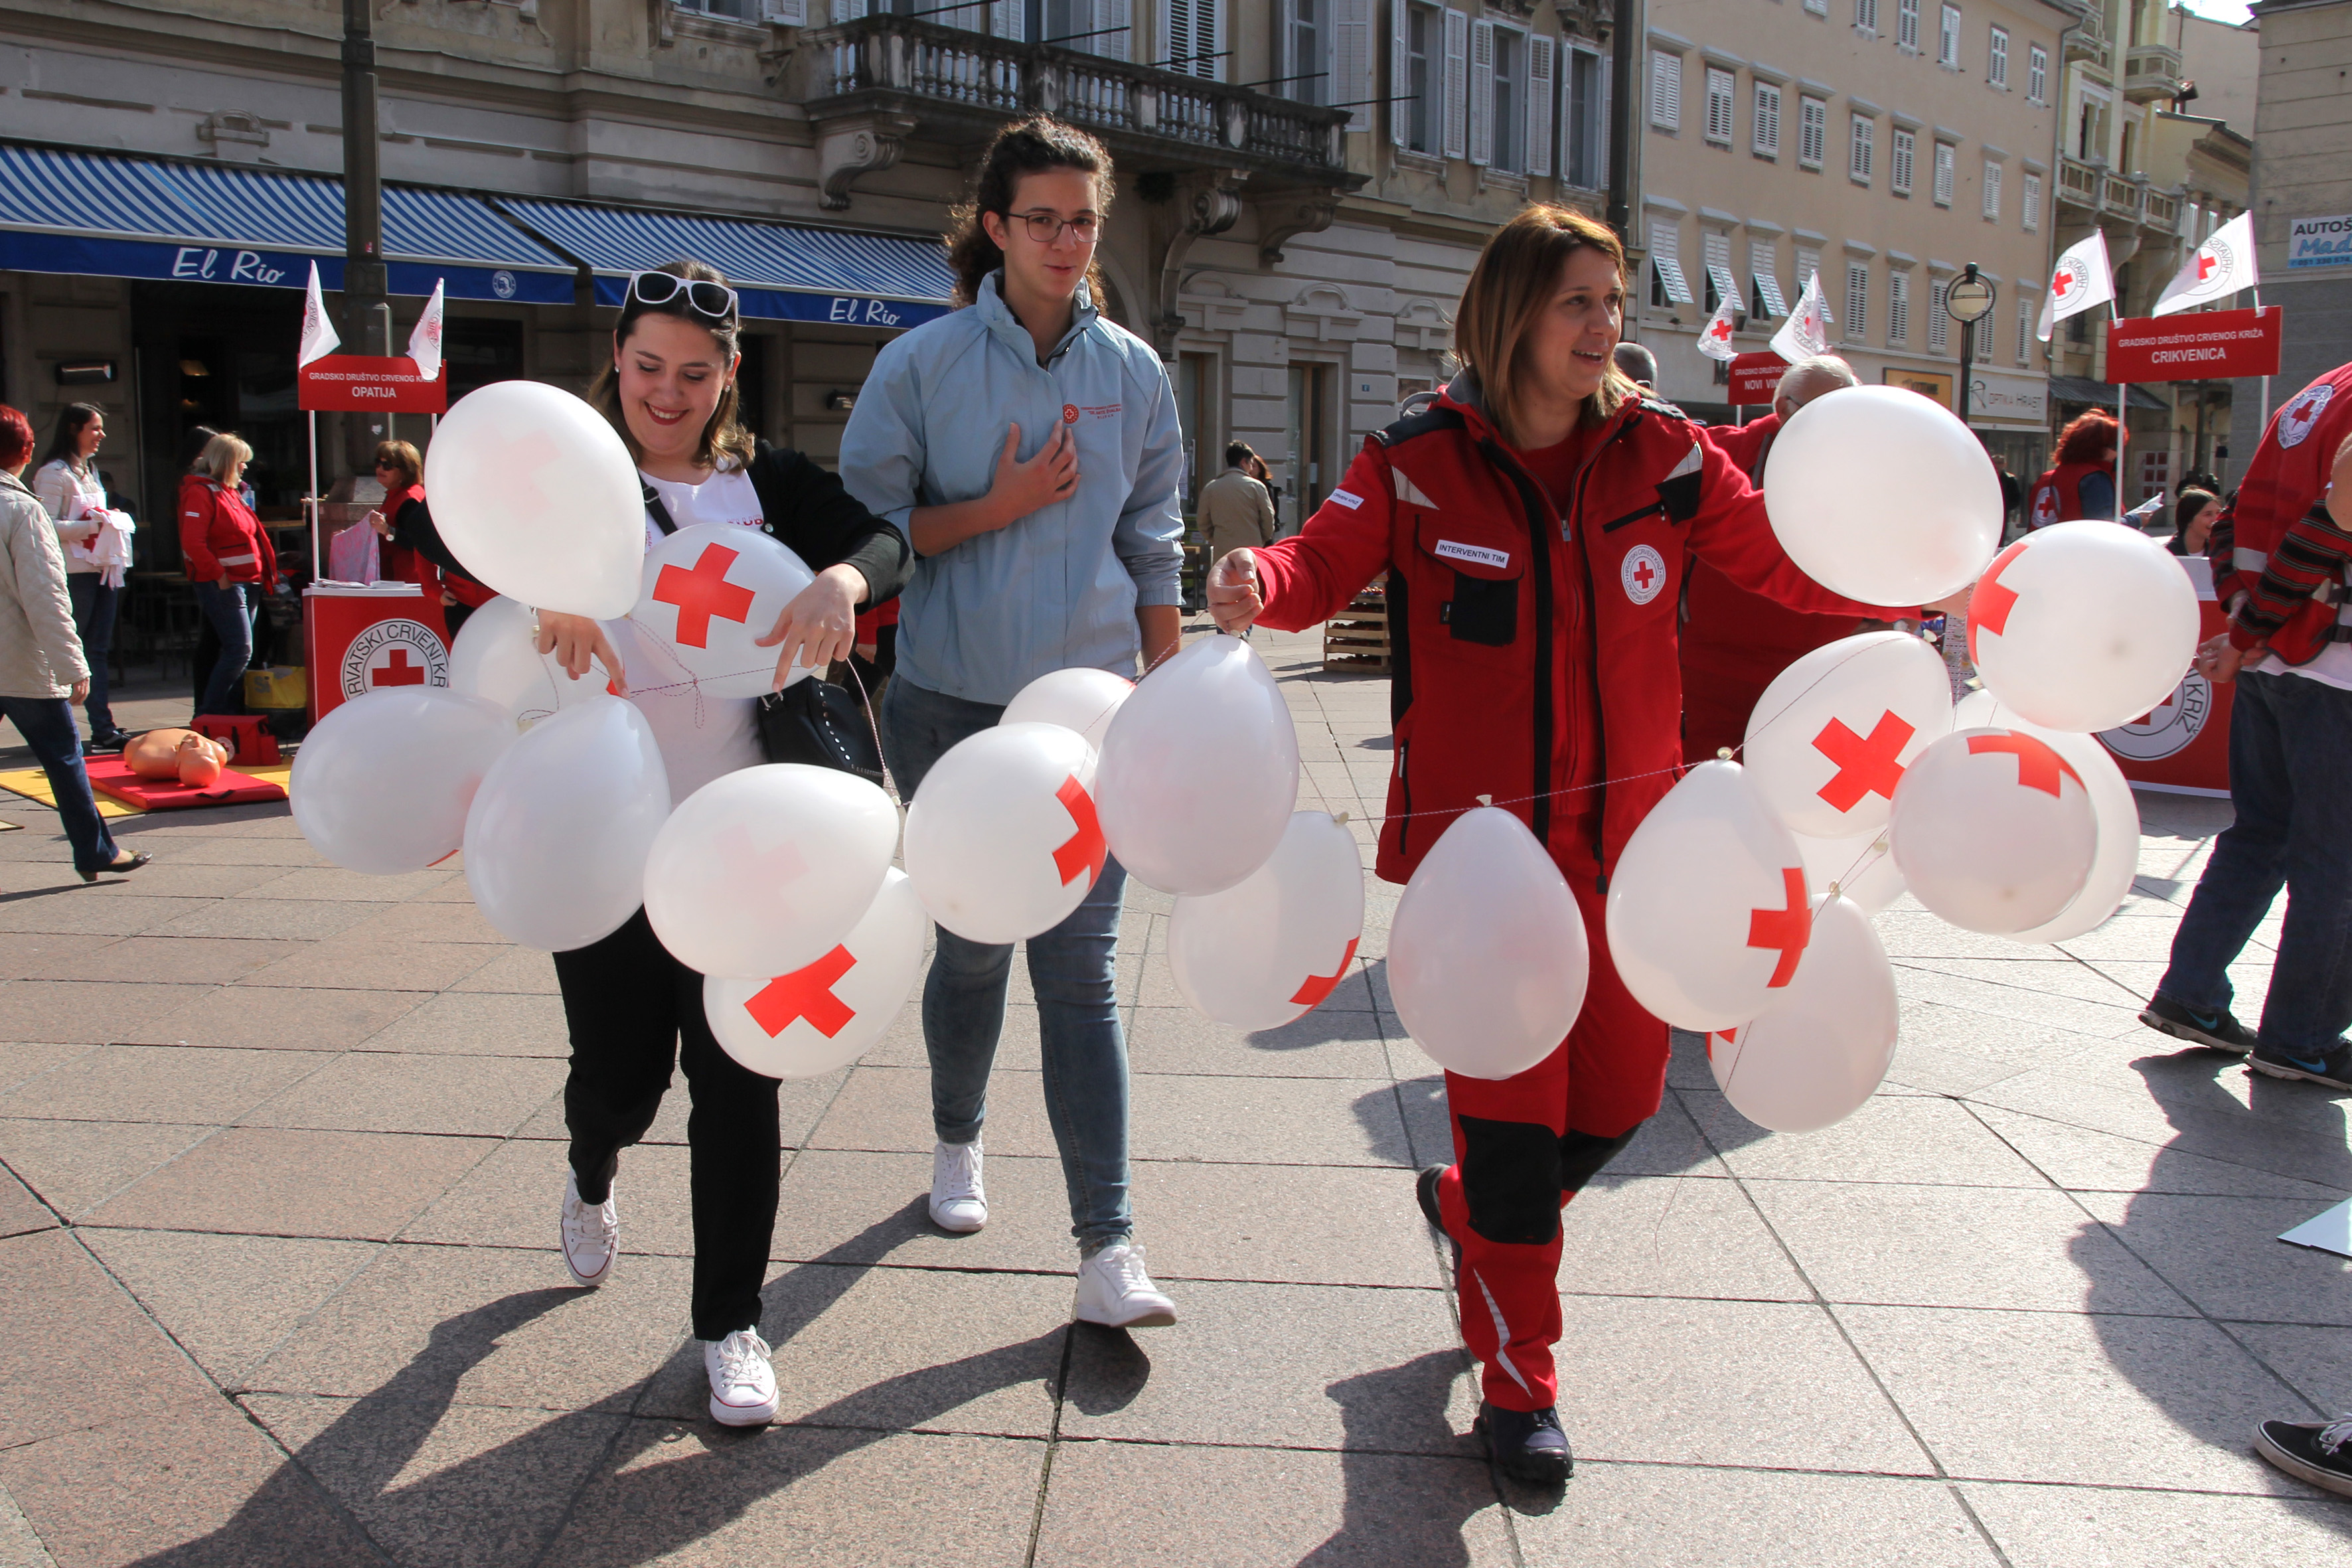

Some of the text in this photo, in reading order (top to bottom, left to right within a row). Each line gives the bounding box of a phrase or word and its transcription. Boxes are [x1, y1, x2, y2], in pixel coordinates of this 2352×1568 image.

[172, 247, 285, 283] El Rio
[830, 297, 901, 325] El Rio
[2118, 327, 2264, 347] GRADSKO DRUŠTVO CRVENOG KRIŽA
[2151, 347, 2227, 364] CRIKVENICA
[346, 372, 380, 382] DRUŠTVO
[1759, 366, 1782, 374] DRUŠTVO
[352, 386, 397, 398] OPATIJA
[1745, 380, 1763, 390] NOVI
[1439, 544, 1506, 563] INTERVENTNI TIM
[346, 629, 384, 696] RVATSKI
[386, 623, 442, 661] CRVENI
[2175, 684, 2204, 735] KRIŽ
